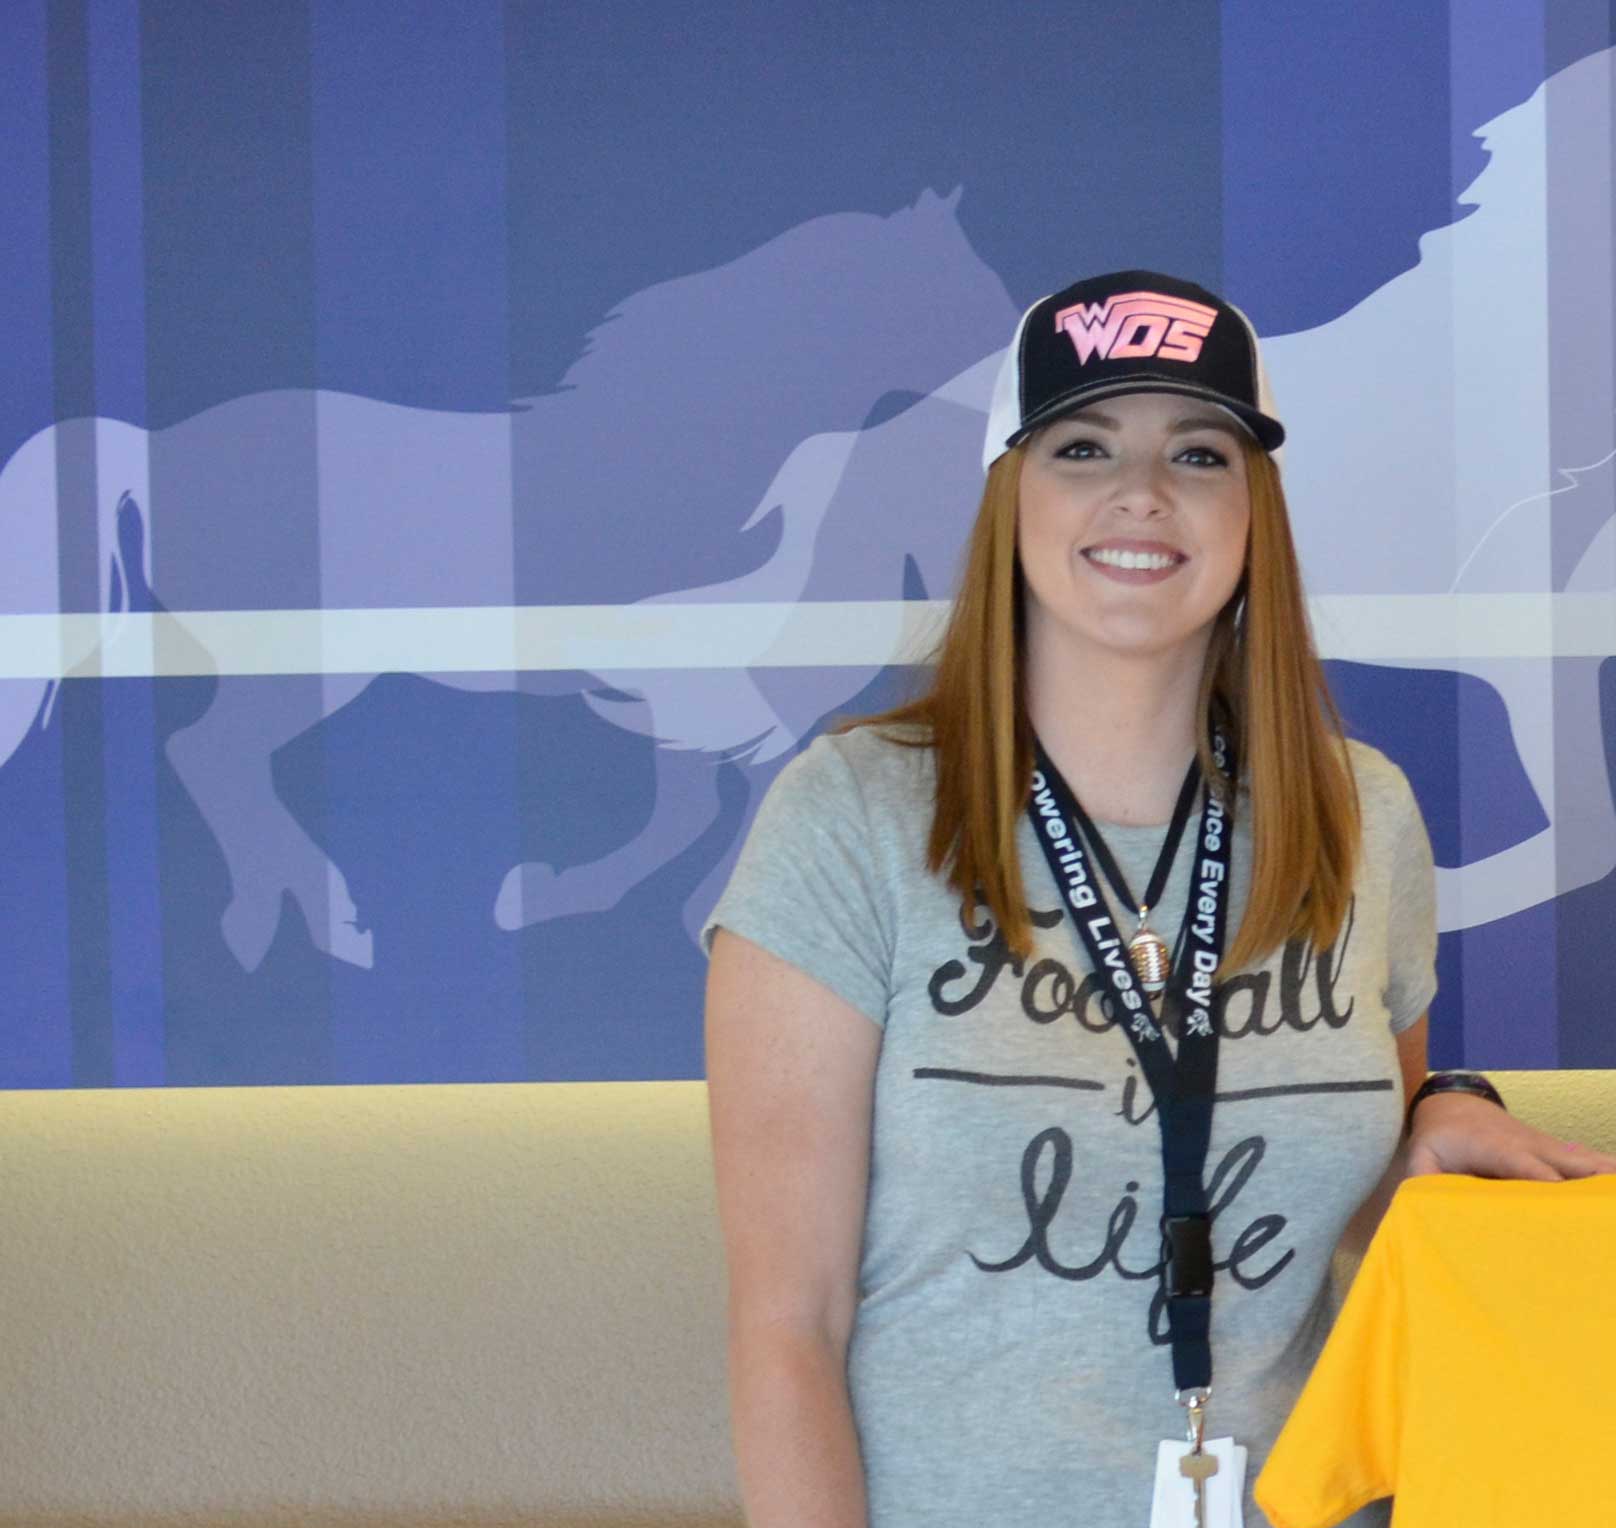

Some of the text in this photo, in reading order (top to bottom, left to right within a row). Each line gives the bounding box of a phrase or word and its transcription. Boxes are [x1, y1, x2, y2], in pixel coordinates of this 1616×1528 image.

[1055, 291, 1218, 366] WOS
[1030, 770, 1142, 1011] owering Lives
[1190, 860, 1224, 944] Every
[929, 890, 1354, 1039] Fooall
[1186, 951, 1218, 1006] Day
